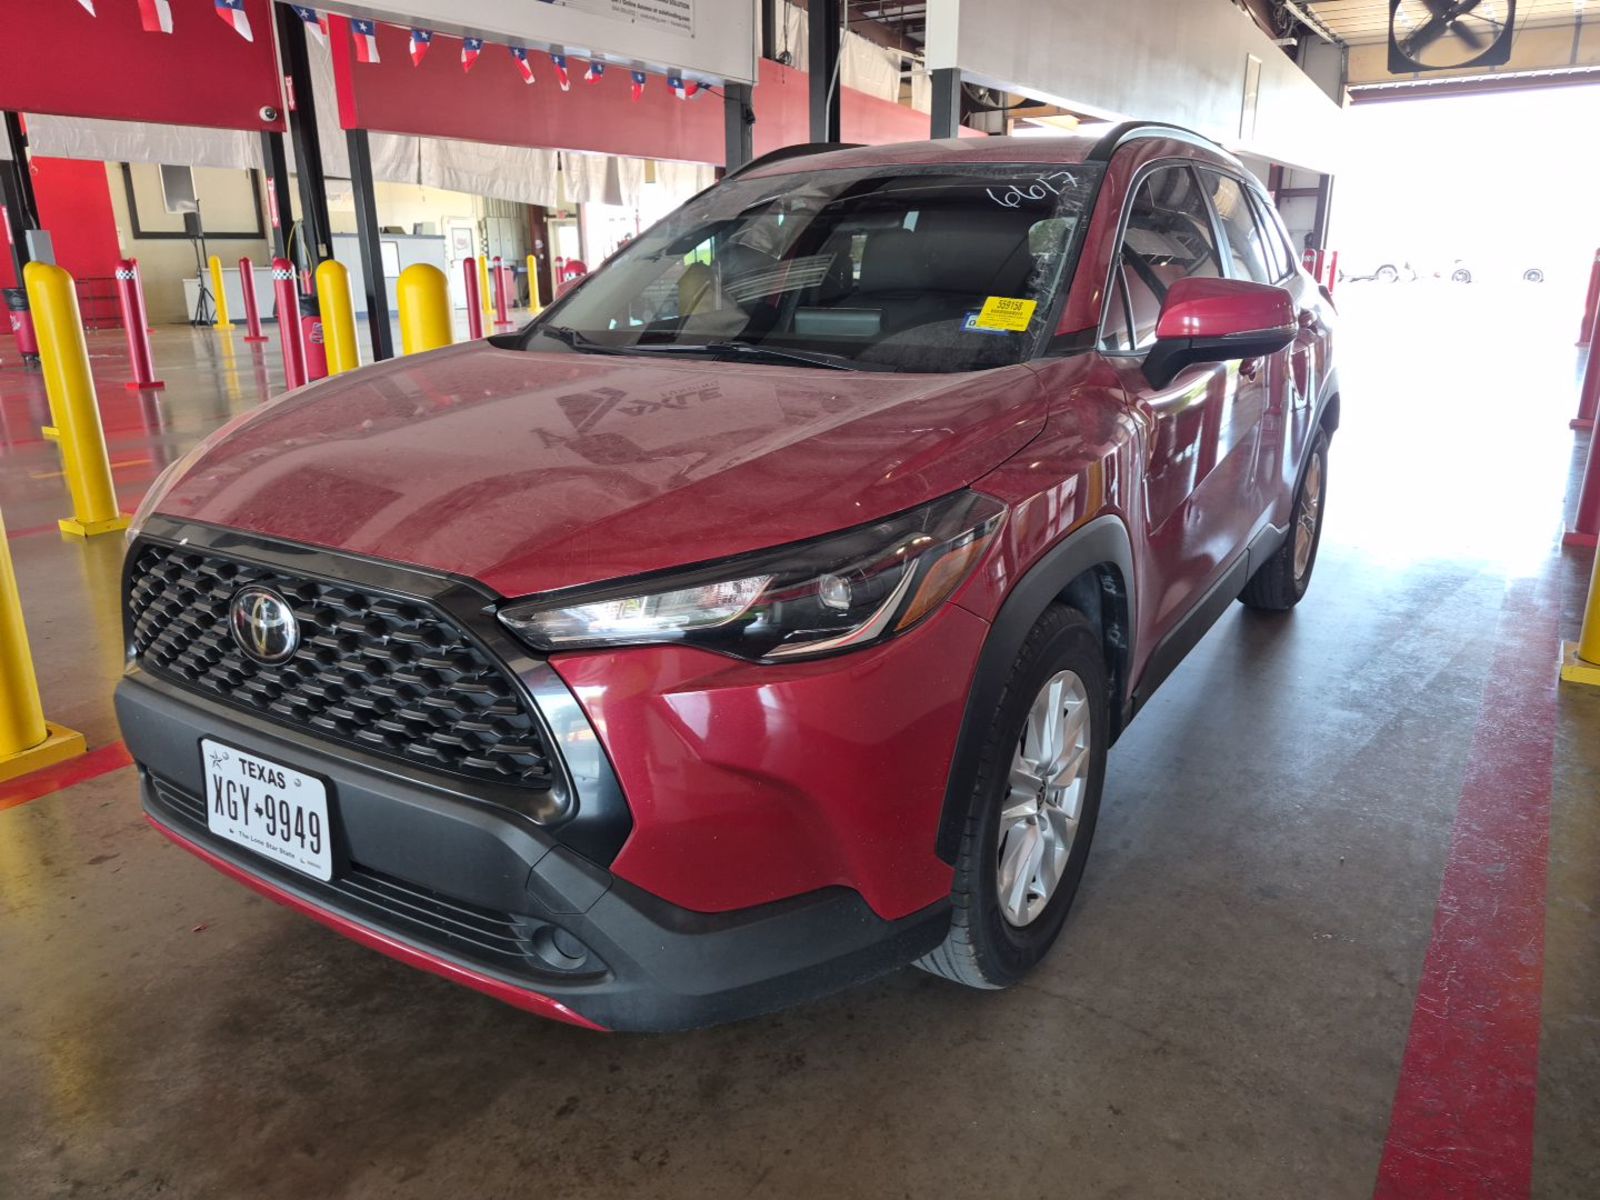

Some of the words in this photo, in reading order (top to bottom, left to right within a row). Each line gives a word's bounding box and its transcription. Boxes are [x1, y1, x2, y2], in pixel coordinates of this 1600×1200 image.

[238, 757, 286, 789] TEXAS
[239, 831, 249, 840] The
[250, 835, 265, 846] Lone
[266, 840, 278, 851] Star
[279, 847, 295, 859] State
